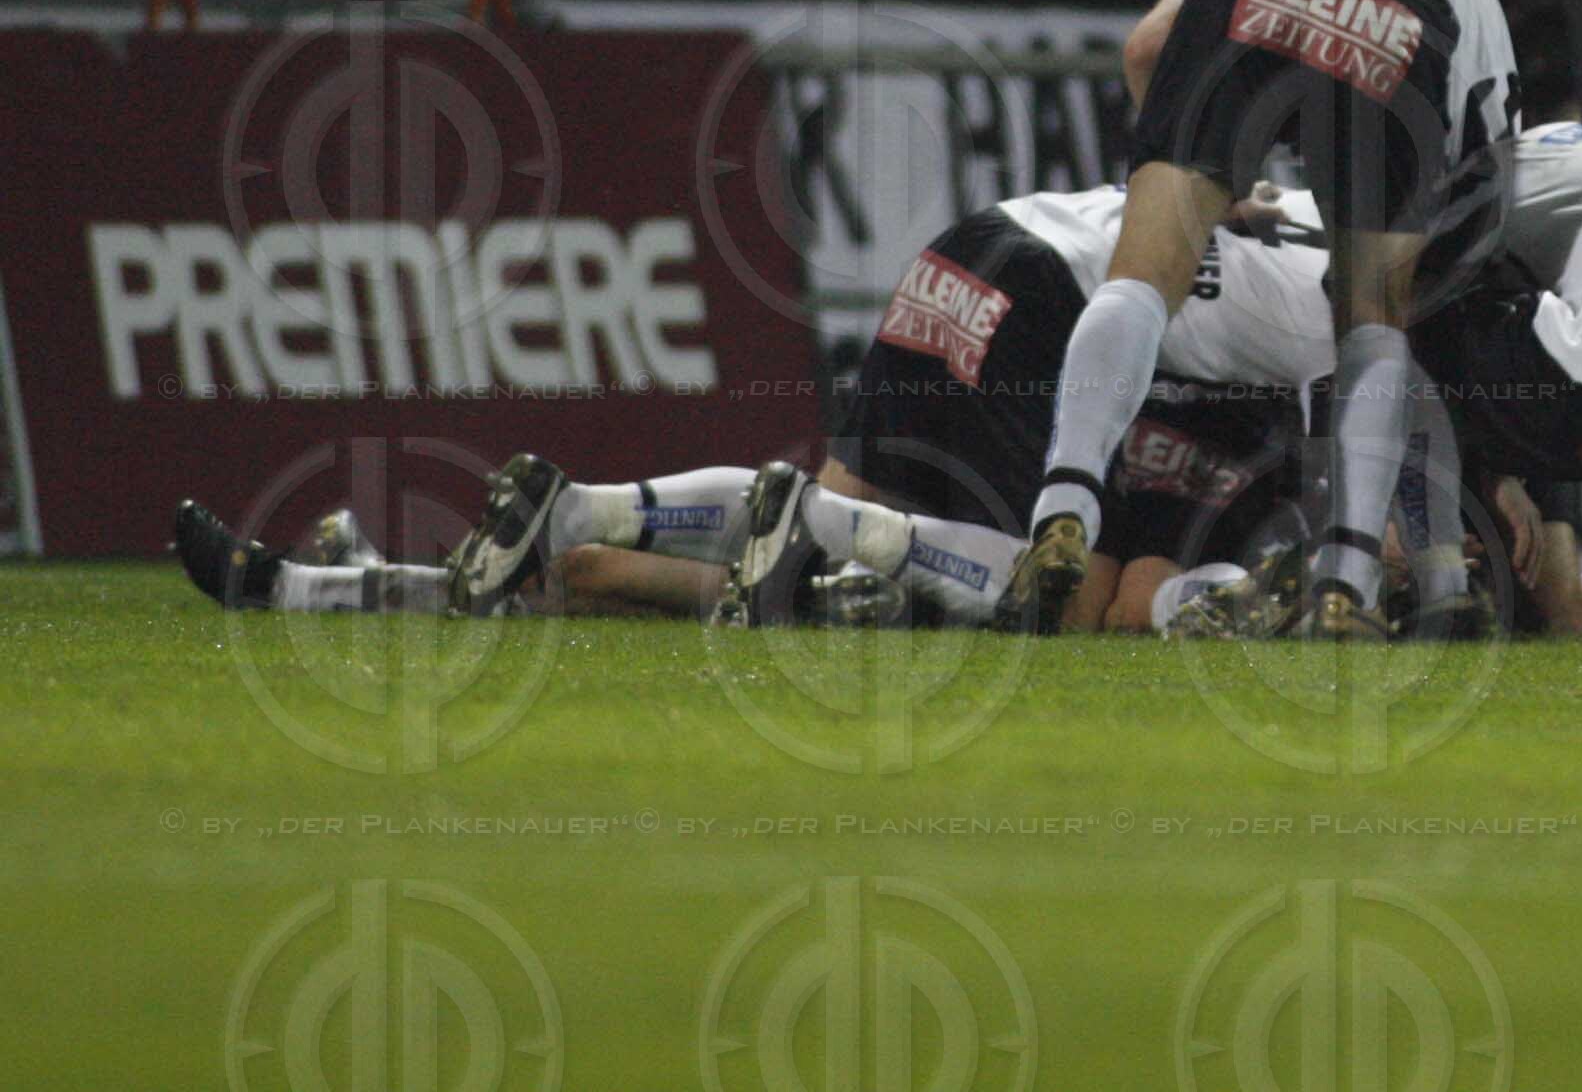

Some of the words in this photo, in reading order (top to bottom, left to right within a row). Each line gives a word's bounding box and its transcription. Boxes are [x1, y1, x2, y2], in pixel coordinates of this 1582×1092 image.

[1239, 4, 1395, 93] ZEITUNG
[87, 216, 718, 400] PREMIERE
[900, 258, 1011, 338] KLEINE
